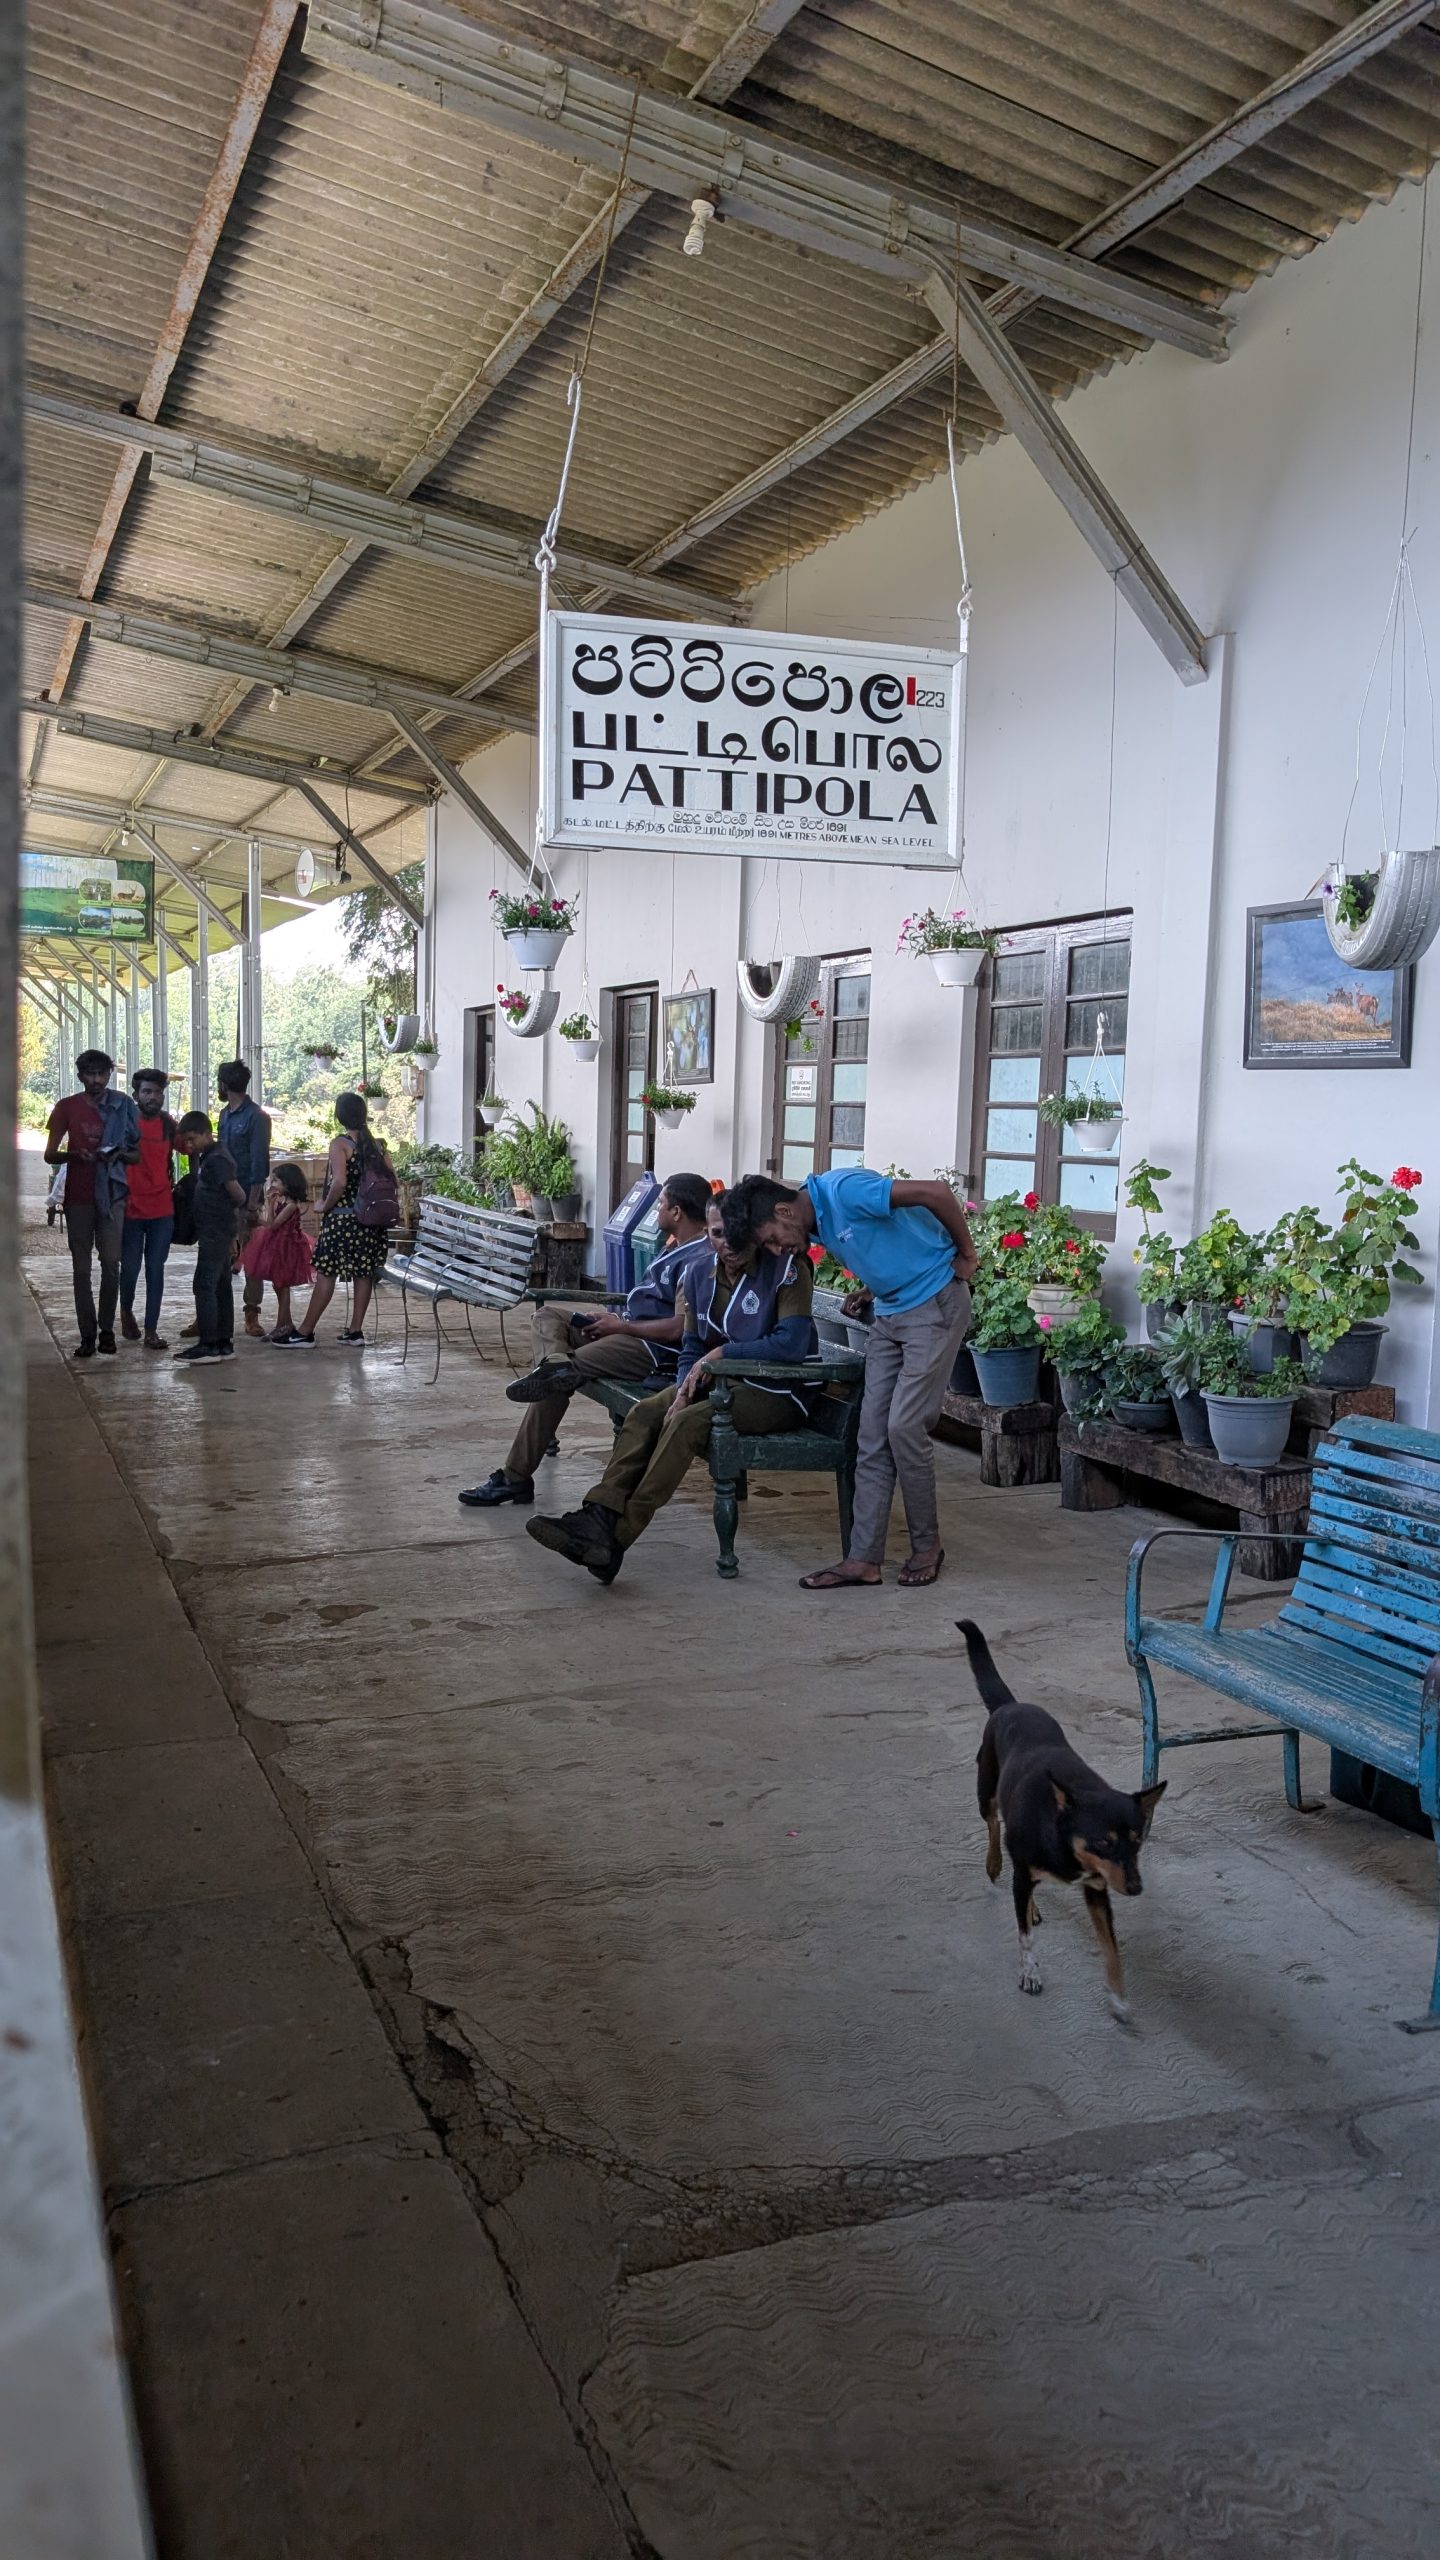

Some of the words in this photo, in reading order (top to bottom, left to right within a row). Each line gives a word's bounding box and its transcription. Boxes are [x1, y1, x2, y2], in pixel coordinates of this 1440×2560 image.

[572, 634, 905, 724] පට්ටිපොල
[916, 690, 945, 708] 223
[572, 711, 942, 773] பட்டிபொல
[572, 759, 938, 824] PATTIPOLA
[757, 829, 777, 838] 1891
[779, 831, 817, 841] METRES
[819, 833, 849, 843] ABOVE
[849, 835, 877, 845] MEAN
[881, 836, 899, 845] SEA
[902, 837, 935, 848] LEVEL
[826, 822, 847, 832] 1891
